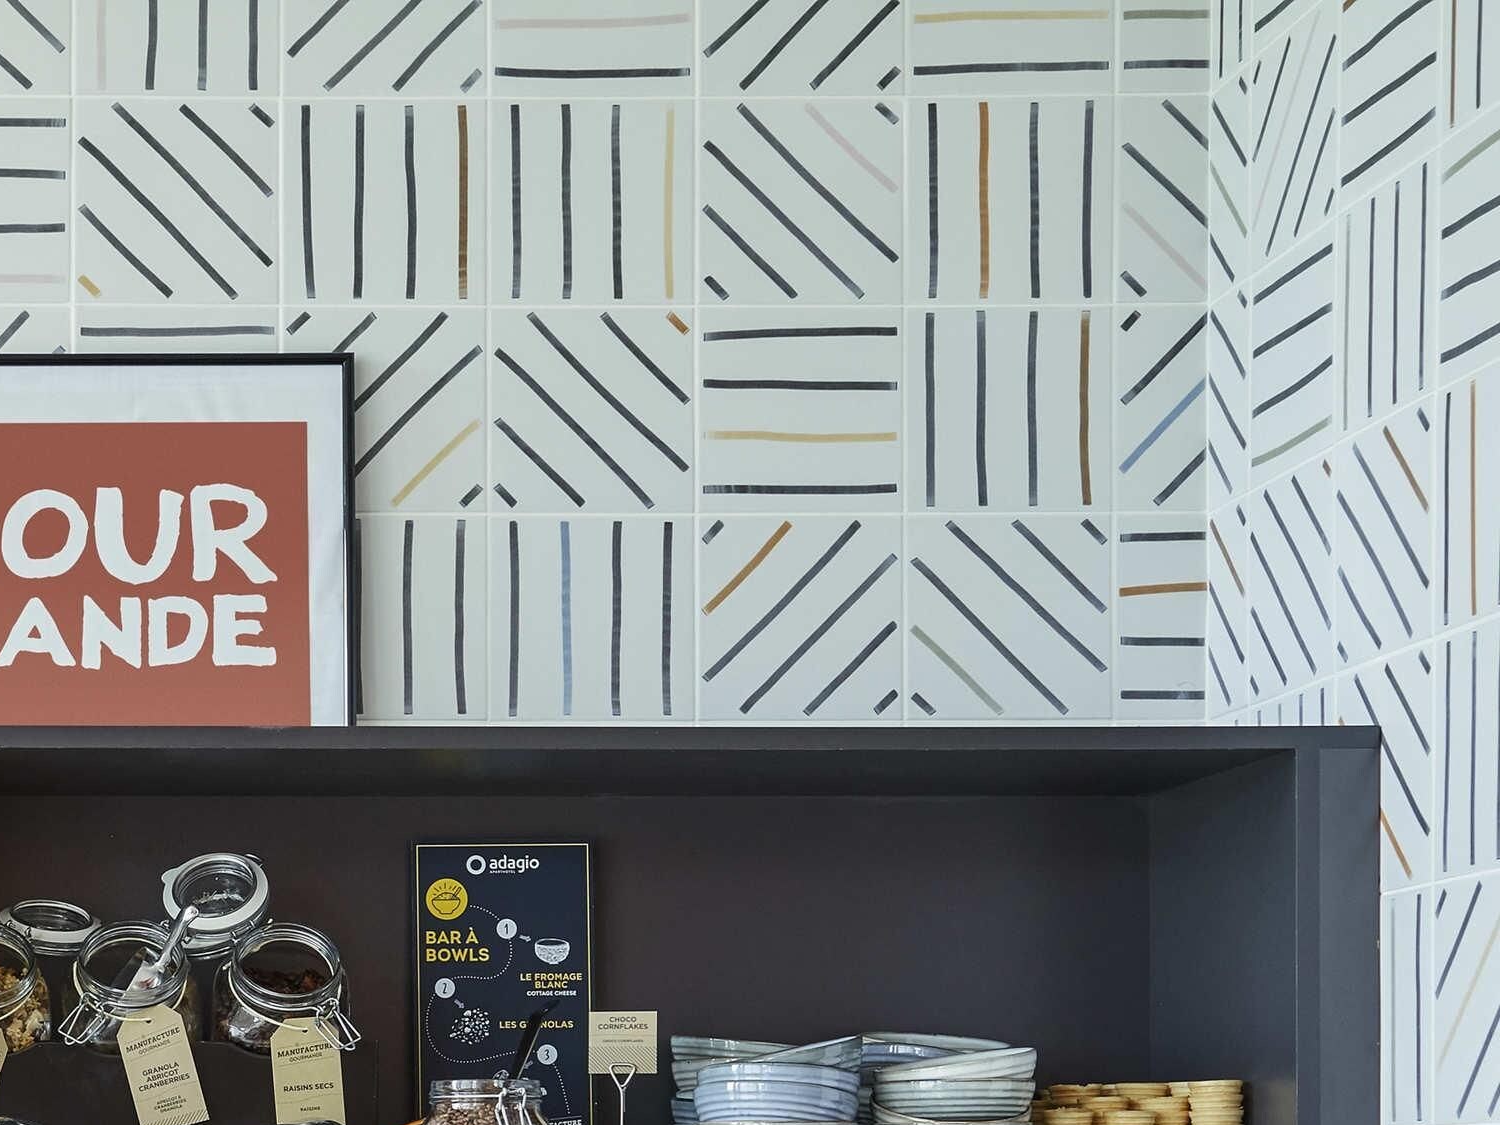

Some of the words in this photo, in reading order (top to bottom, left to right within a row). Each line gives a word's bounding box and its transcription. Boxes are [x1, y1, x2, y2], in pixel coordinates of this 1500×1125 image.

[489, 855, 540, 873] adagio
[425, 931, 461, 944] BAR
[465, 926, 479, 944] À
[425, 948, 490, 962] BOWLS
[520, 973, 532, 981] LE
[534, 973, 583, 981] FROMAGE
[534, 981, 568, 989] BLANC
[499, 1021, 517, 1029] LES
[519, 1020, 574, 1029] GNOLAS
[125, 1027, 181, 1053] MANUFACTURE
[142, 1062, 180, 1077] GRANOLA
[146, 1068, 180, 1083] ABRICOT
[138, 1073, 191, 1092] CRANBERRIES
[283, 1083, 313, 1092] RAISINS
